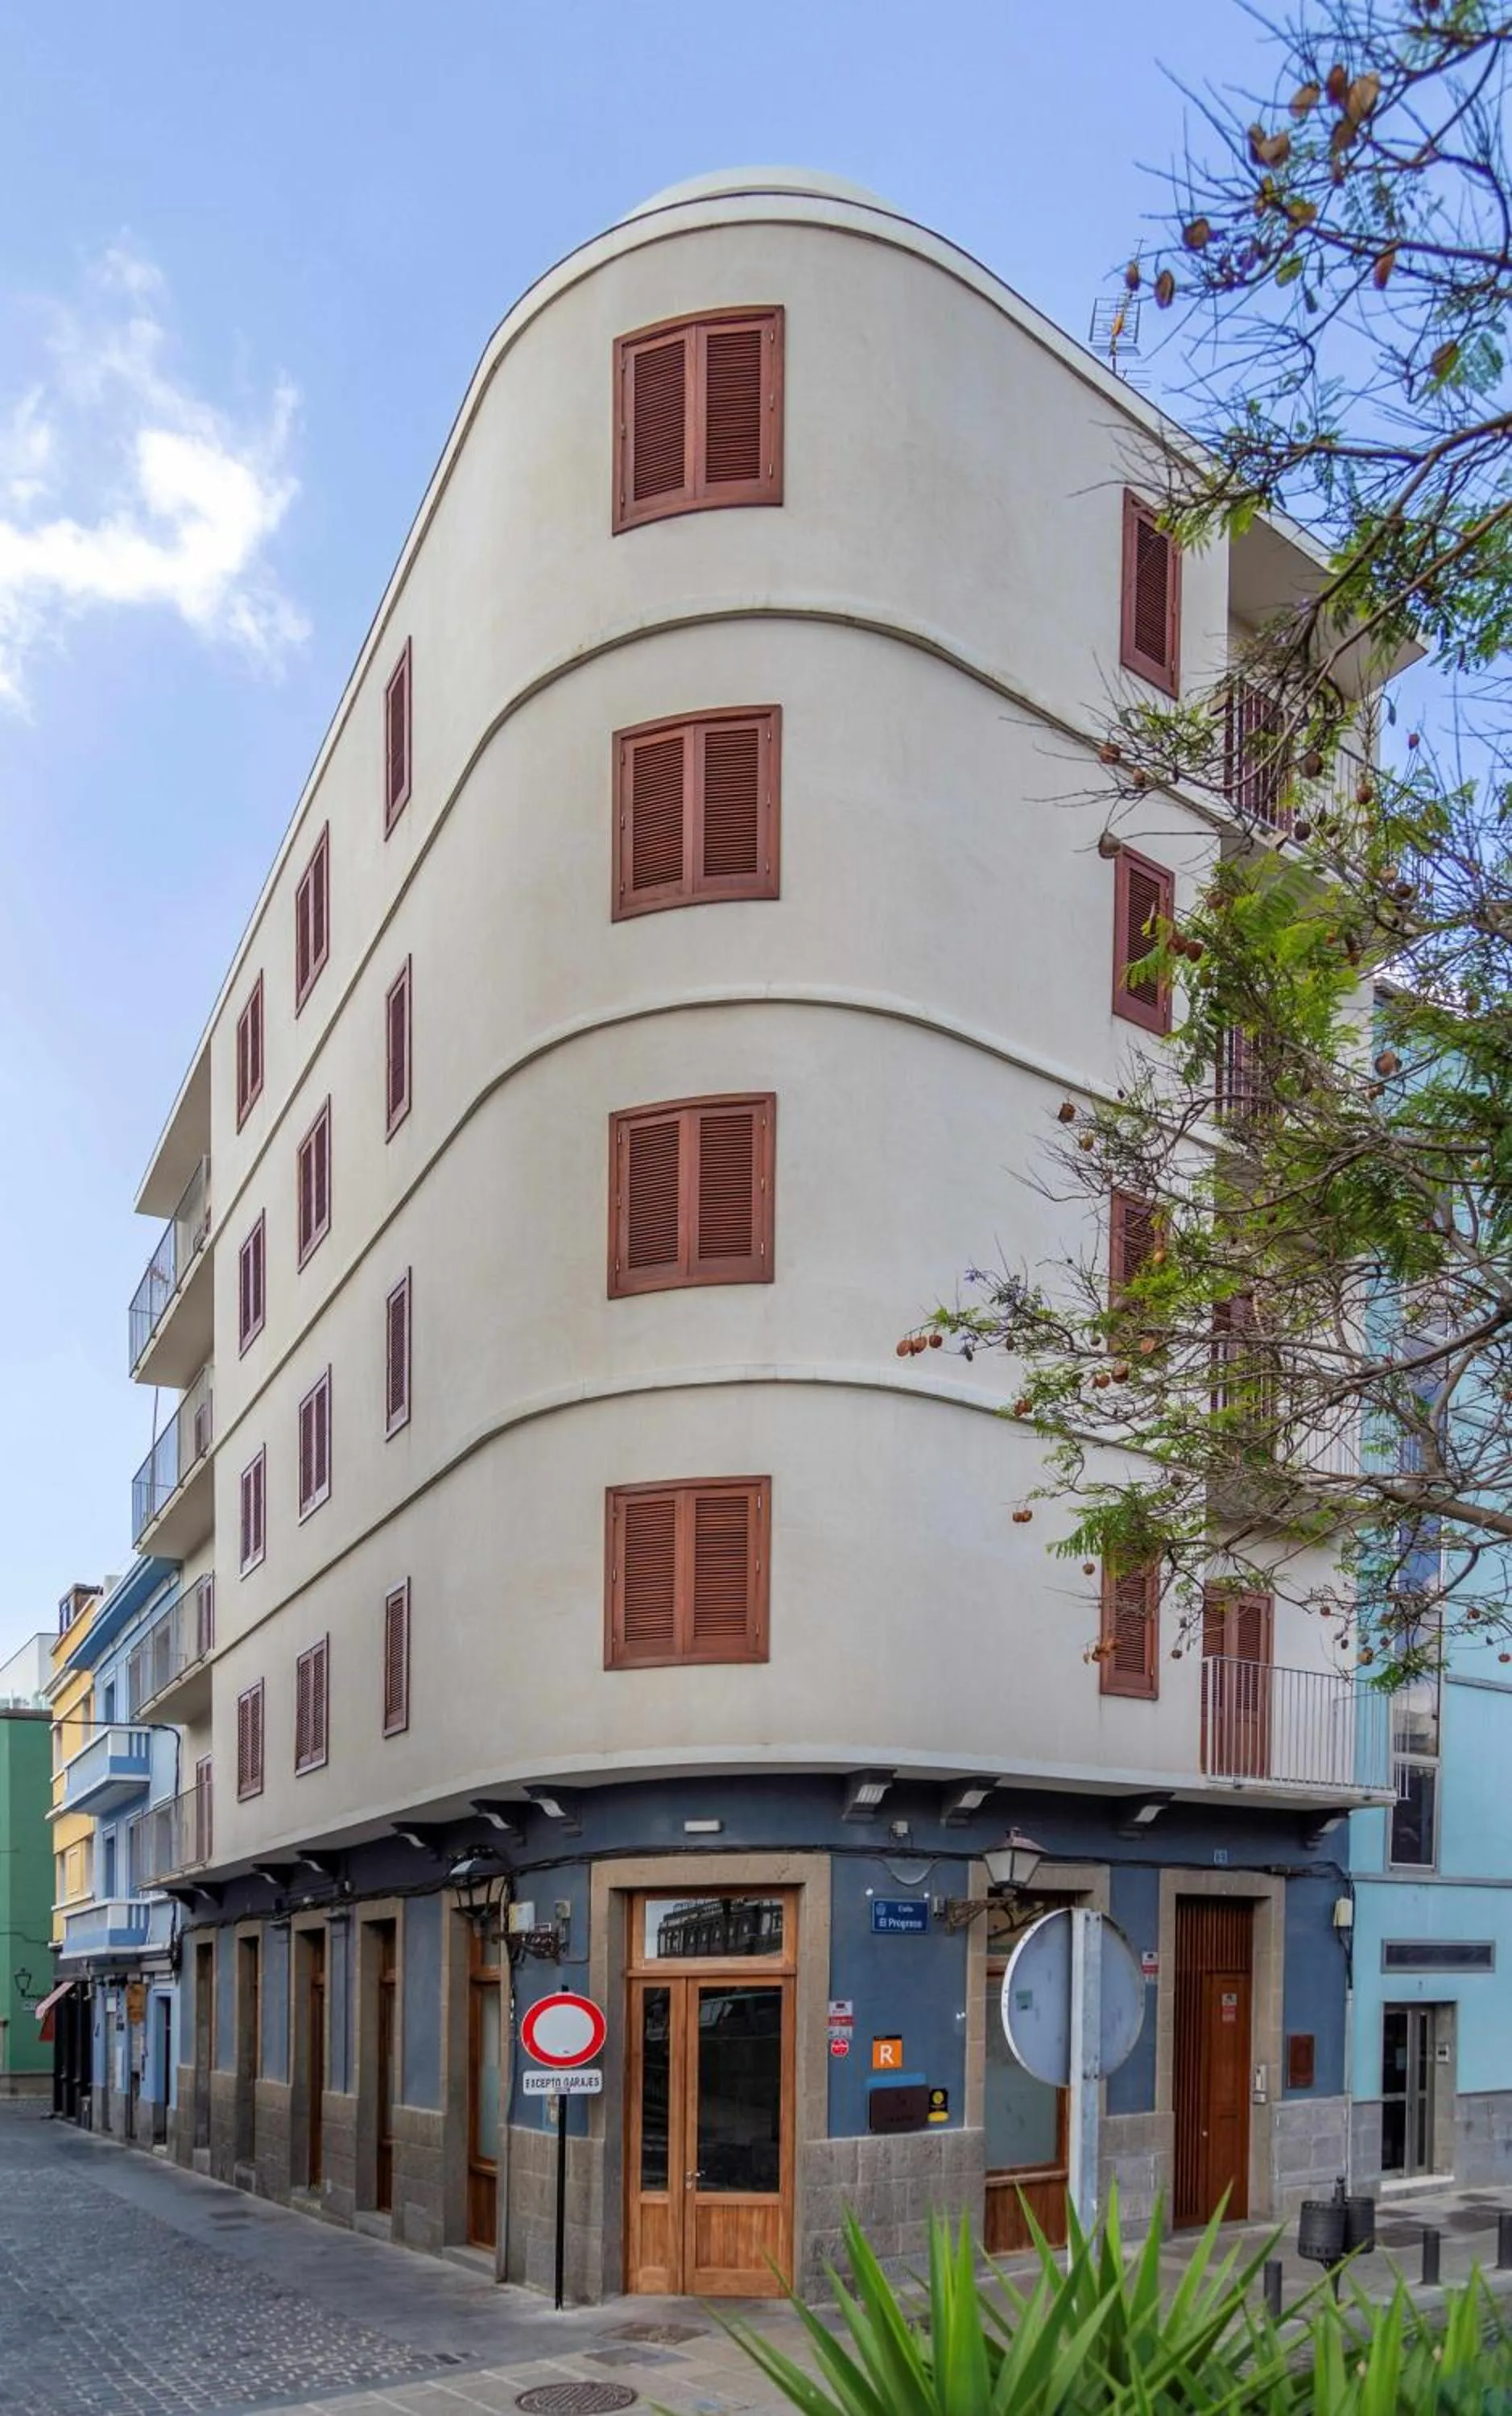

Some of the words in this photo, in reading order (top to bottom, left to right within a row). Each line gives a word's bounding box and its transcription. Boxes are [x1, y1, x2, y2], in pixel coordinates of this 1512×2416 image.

[878, 1917, 886, 1927] El
[888, 1917, 923, 1930] Progreso
[879, 2044, 894, 2065] R
[525, 2078, 561, 2088] EXCEPTO
[564, 2077, 600, 2087] GARAJES
